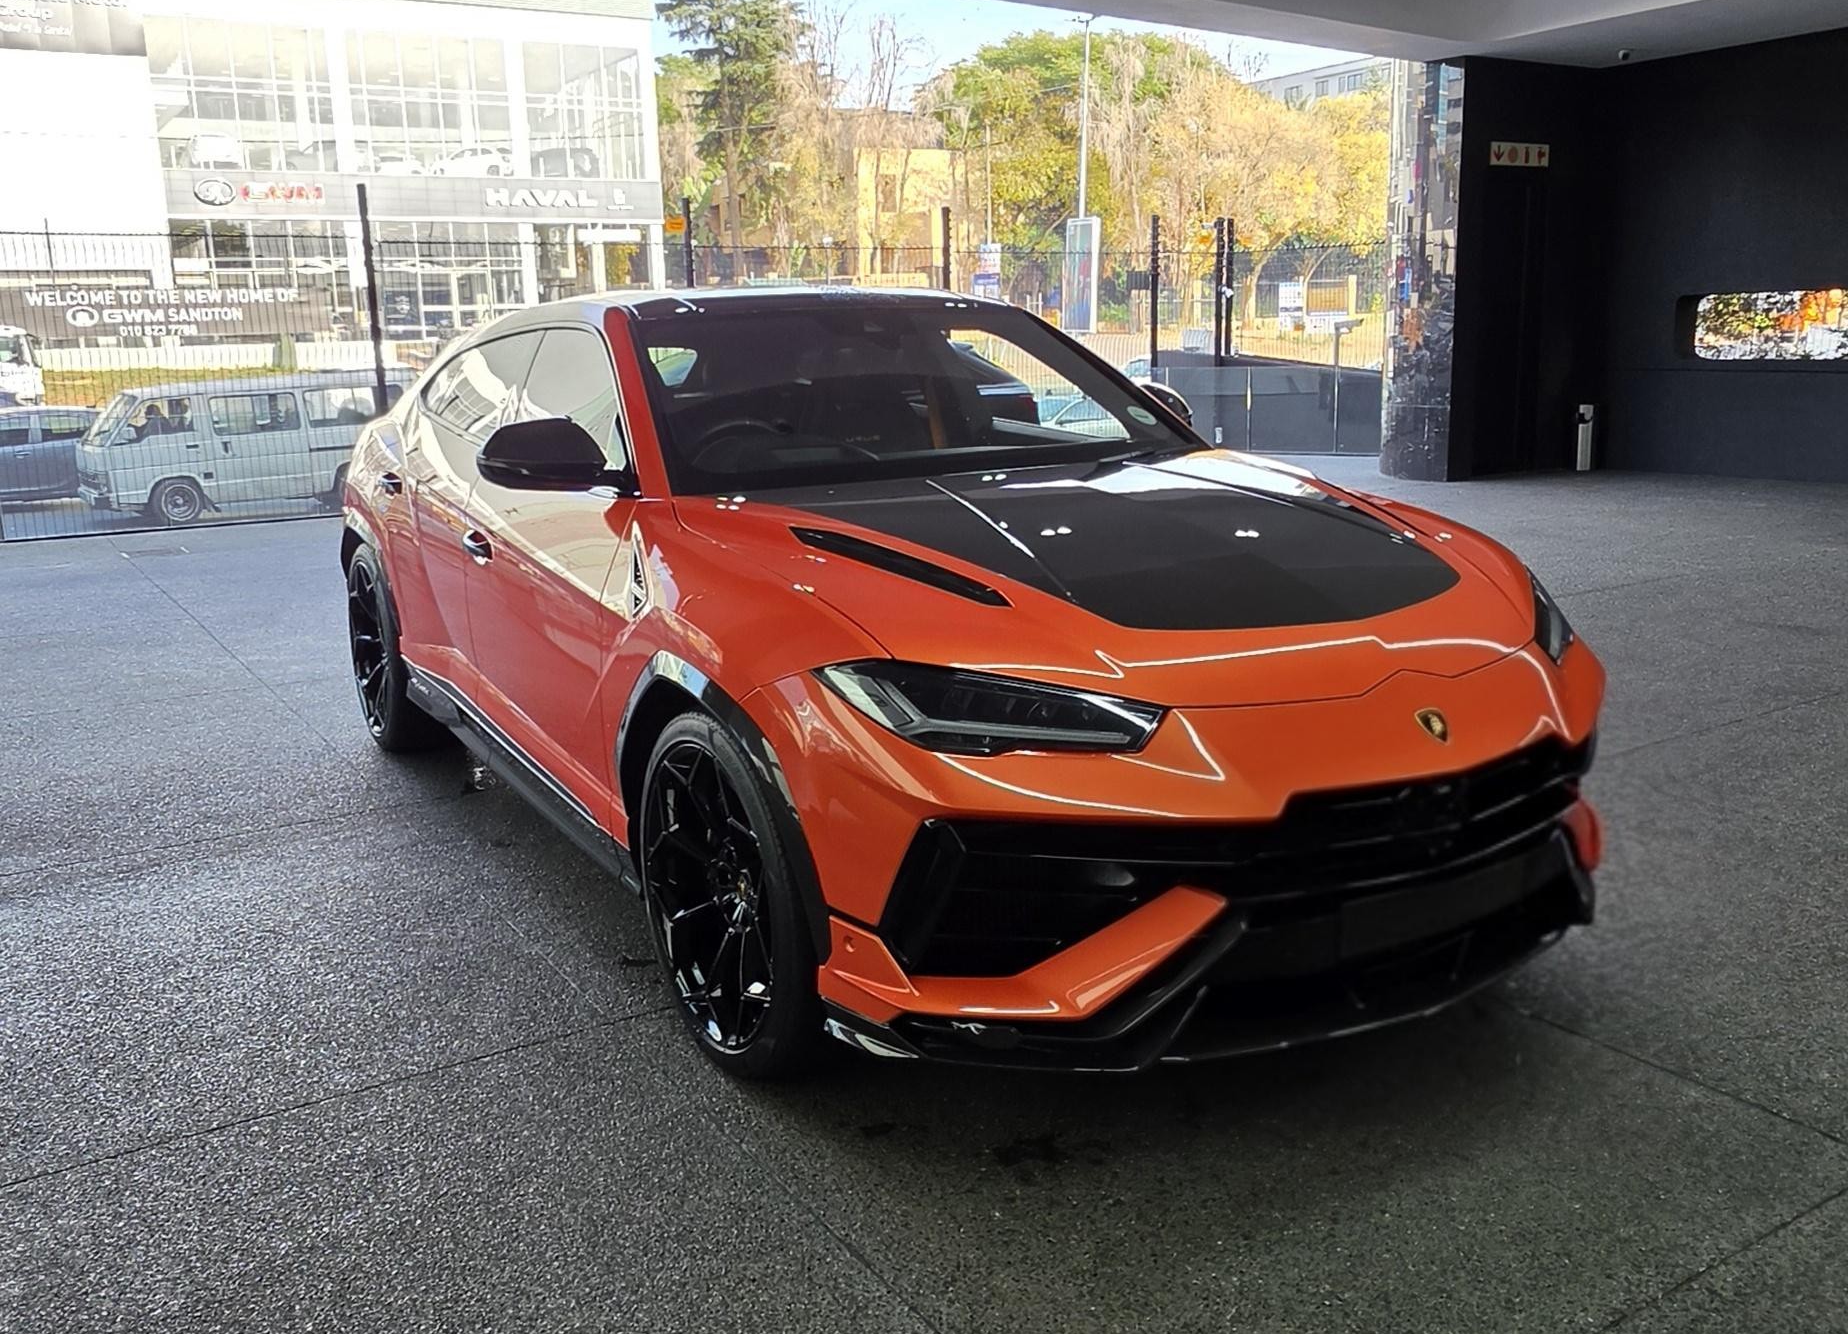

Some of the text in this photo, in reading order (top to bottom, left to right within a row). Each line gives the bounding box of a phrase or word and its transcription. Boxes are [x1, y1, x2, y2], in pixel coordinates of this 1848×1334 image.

[485, 187, 599, 208] HAVAL
[25, 287, 300, 307] WELCOME TO THE NEW HOME OF
[102, 307, 243, 323] GWM SANDTON
